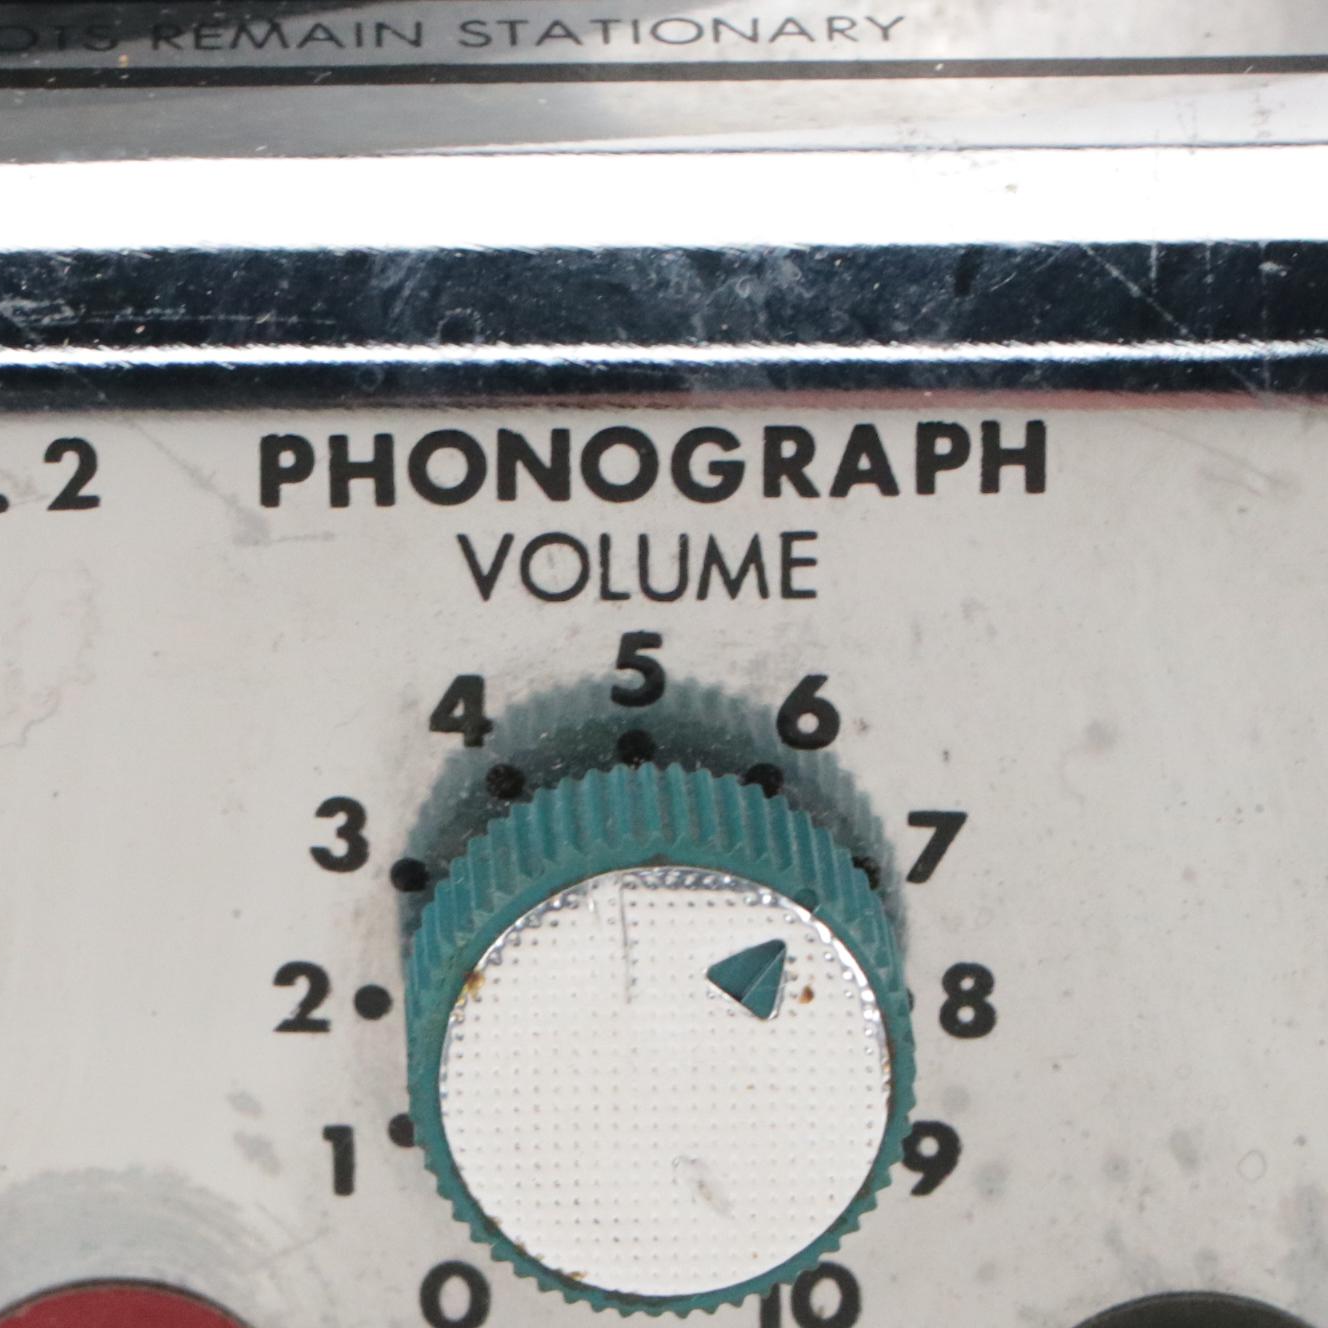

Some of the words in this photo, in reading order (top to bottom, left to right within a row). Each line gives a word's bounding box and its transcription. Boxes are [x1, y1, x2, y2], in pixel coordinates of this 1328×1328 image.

[150, 18, 424, 52] REMAIN
[459, 14, 906, 49] STATIONARY
[44, 437, 101, 510] 2
[259, 419, 1047, 509] PHONOGRAPH
[457, 531, 817, 602] VOLUME
[611, 631, 665, 707] 5
[429, 675, 492, 748] 4
[776, 675, 840, 749] 6
[309, 797, 369, 873] 3
[907, 811, 967, 883] 7
[272, 961, 331, 1033] 2
[939, 963, 997, 1038] 8
[323, 1126, 354, 1196] 1
[902, 1120, 962, 1195] 9
